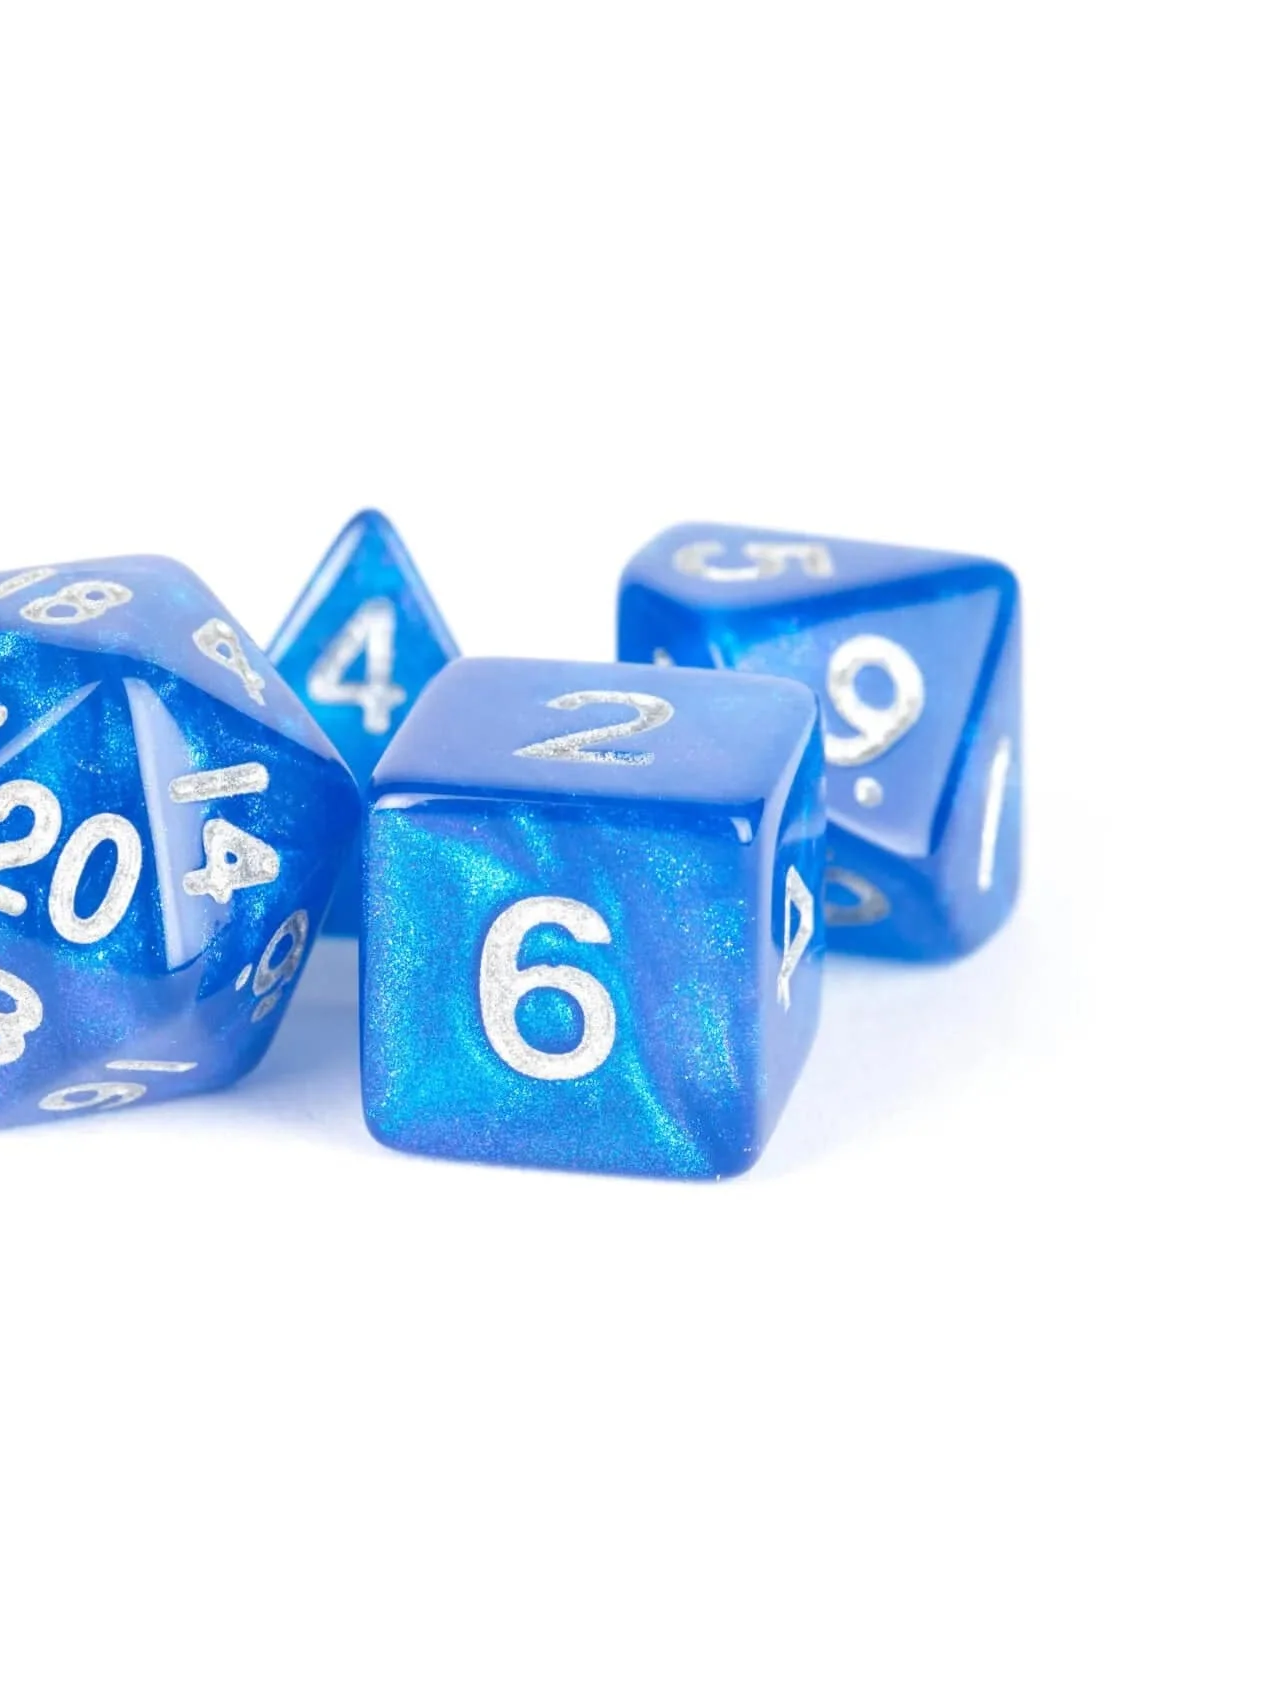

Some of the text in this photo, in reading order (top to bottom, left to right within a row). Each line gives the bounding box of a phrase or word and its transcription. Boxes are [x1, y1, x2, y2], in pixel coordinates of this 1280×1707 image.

[673, 540, 835, 582] 5
[307, 598, 406, 735] 4
[513, 690, 675, 766] 2
[168, 761, 281, 904] 14
[477, 896, 617, 1081] 6
[777, 865, 815, 1013] 4
